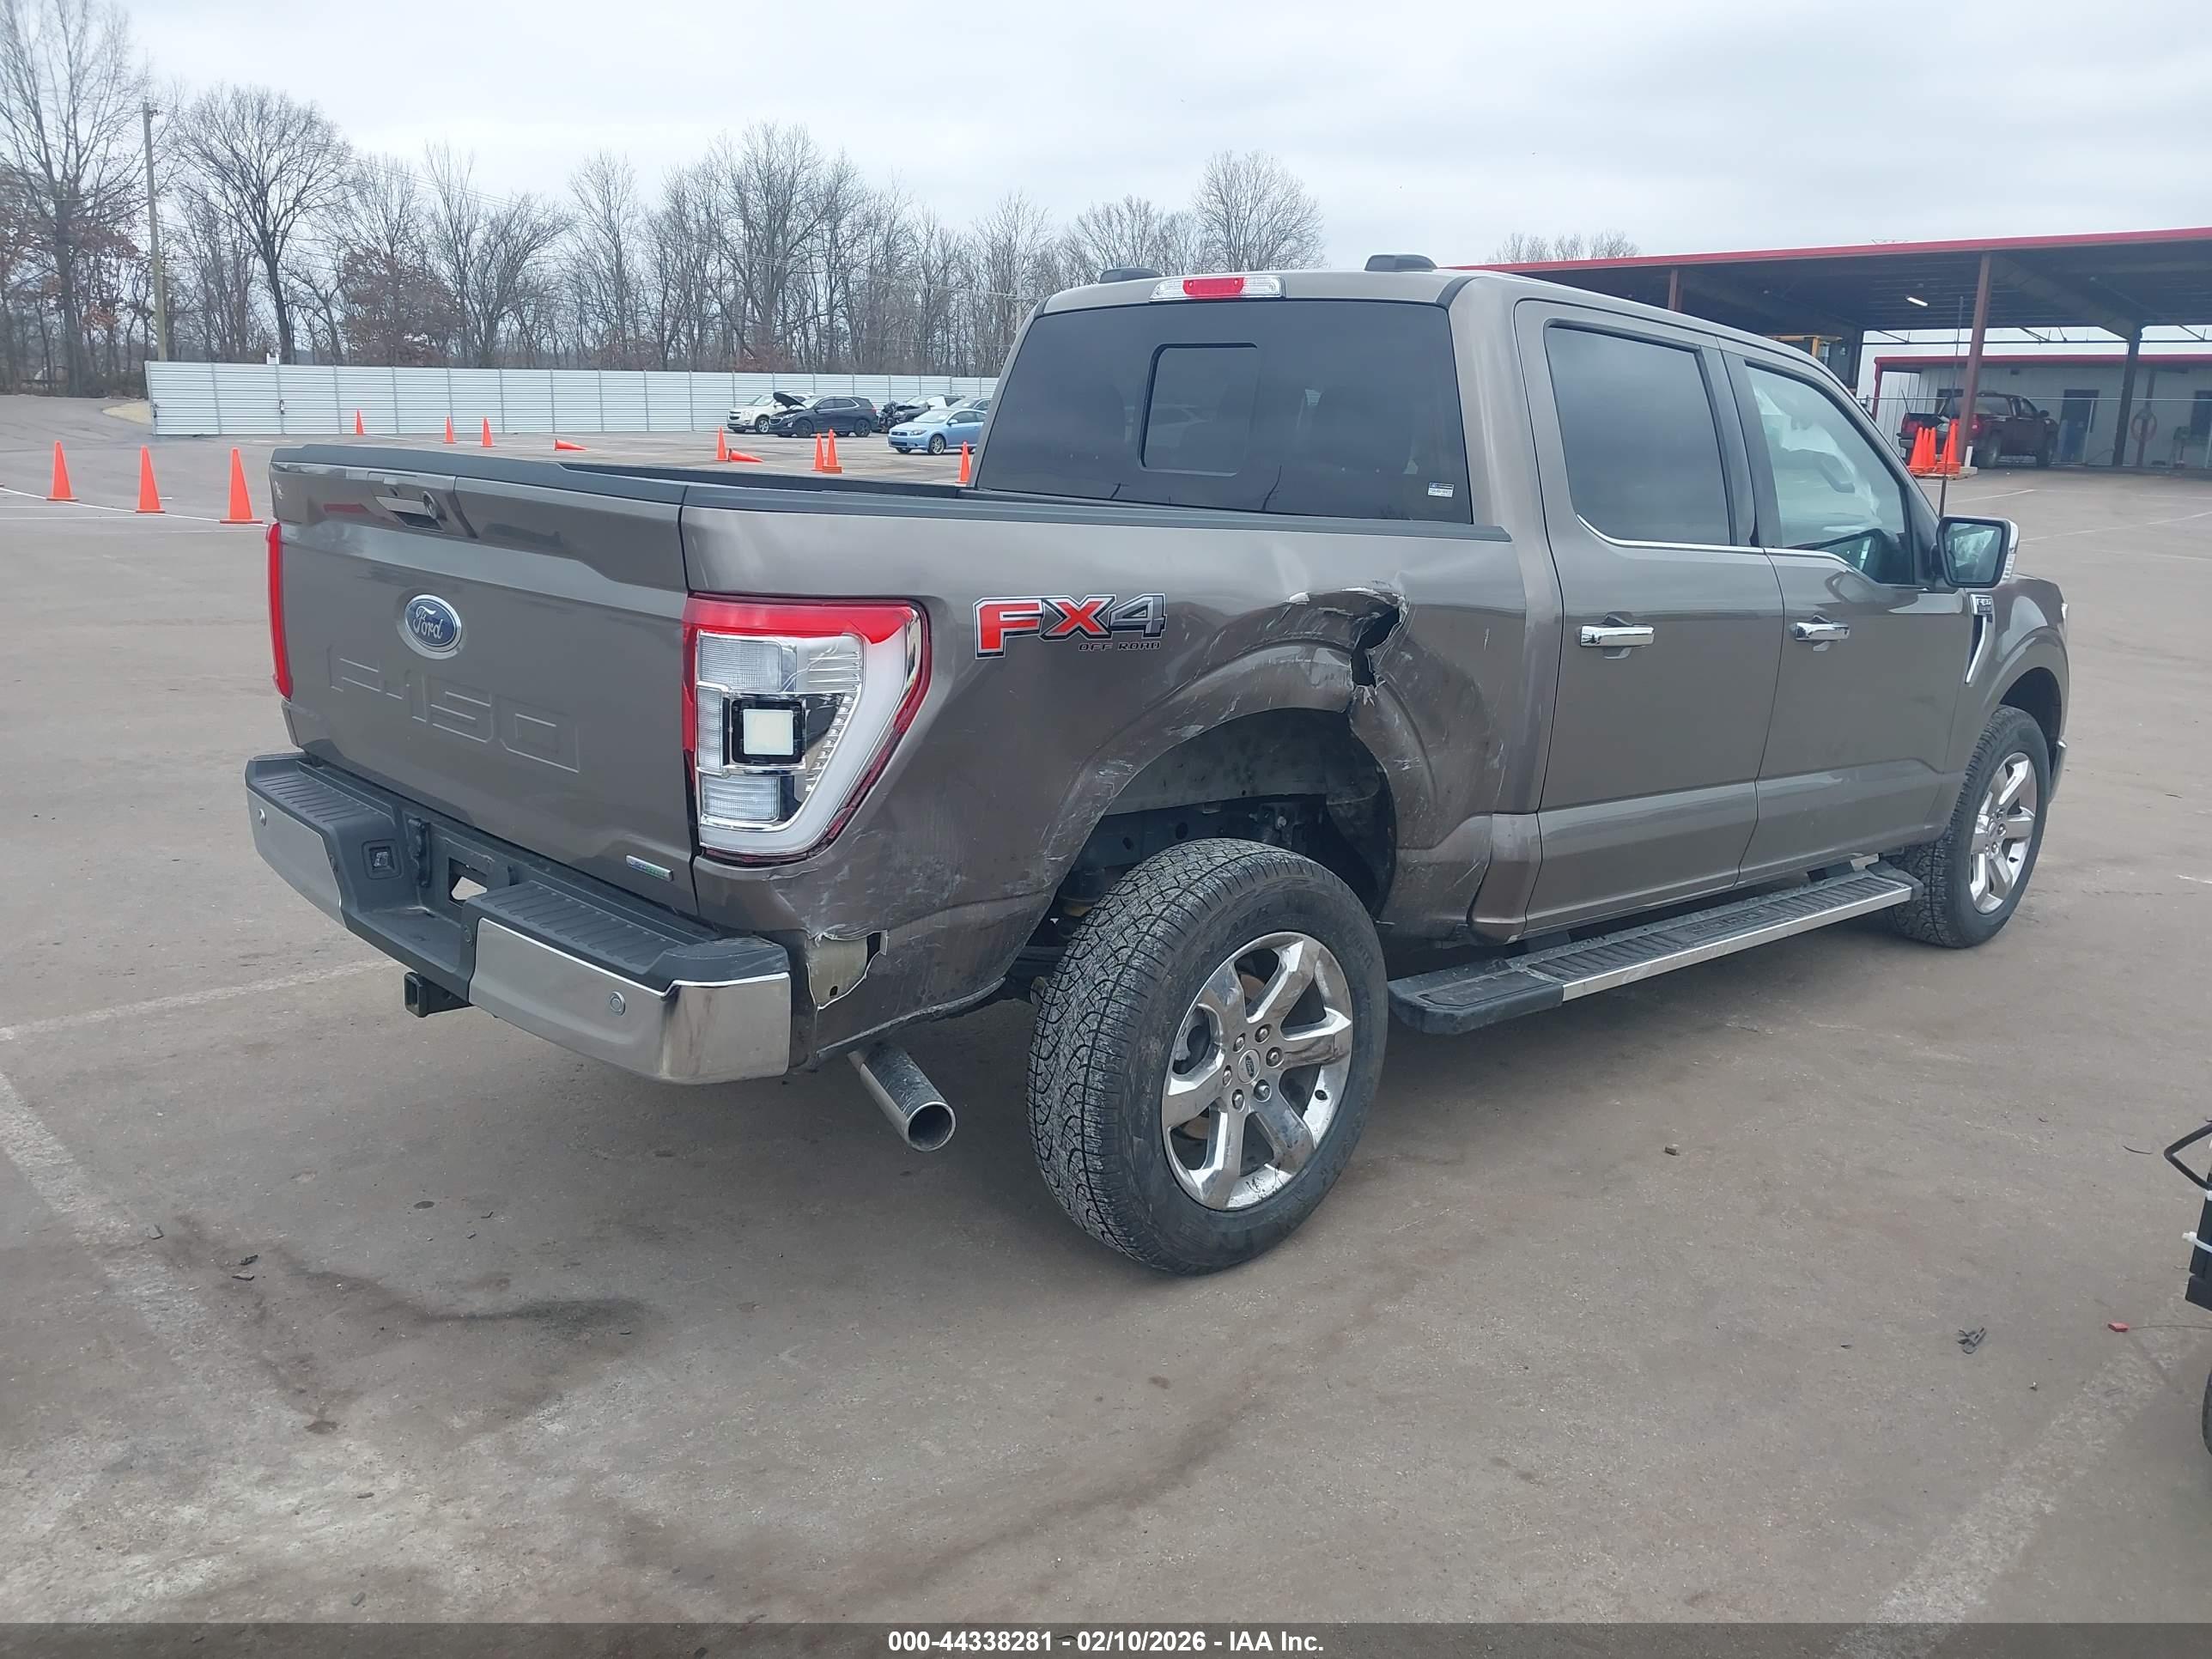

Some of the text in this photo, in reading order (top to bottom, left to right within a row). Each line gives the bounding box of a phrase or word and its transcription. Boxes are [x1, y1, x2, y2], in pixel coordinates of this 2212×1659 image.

[412, 605, 444, 639] Ford
[973, 592, 1167, 659] FX4
[1079, 641, 1162, 652] OFF ROAD
[325, 641, 581, 775] F-150
